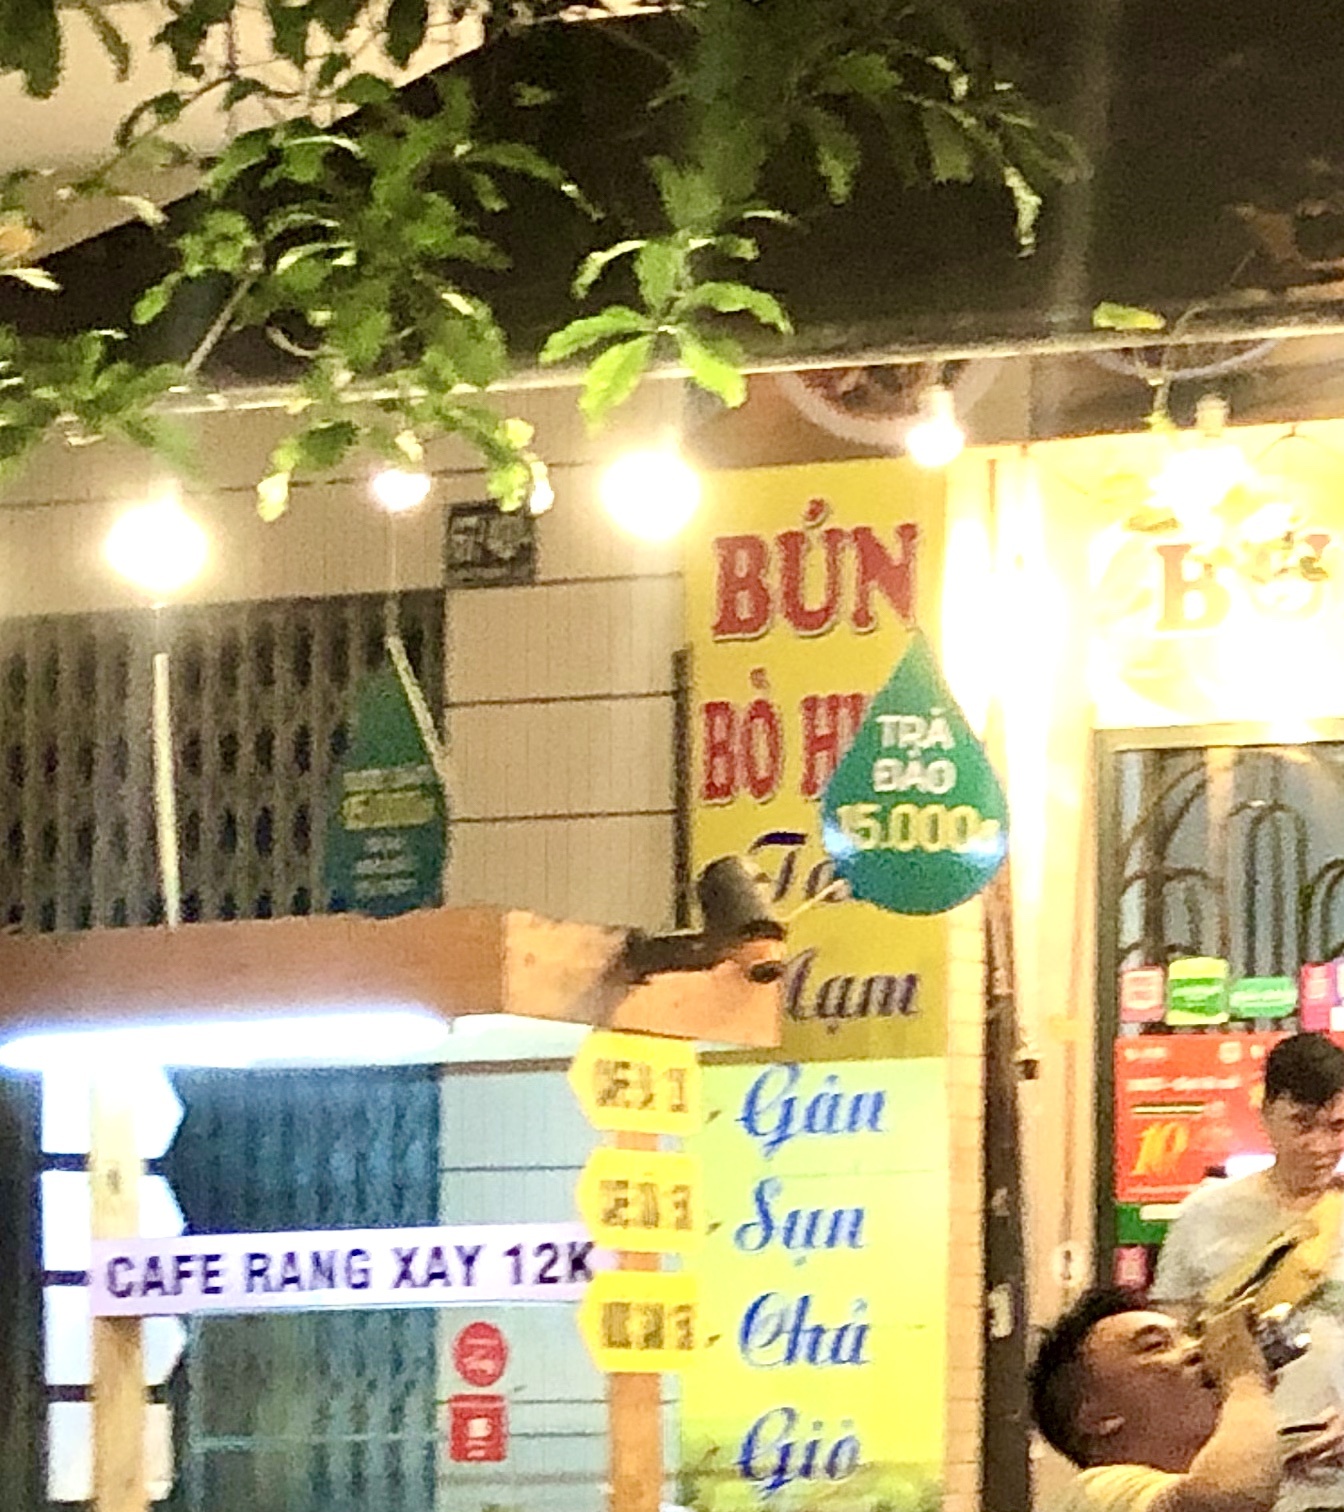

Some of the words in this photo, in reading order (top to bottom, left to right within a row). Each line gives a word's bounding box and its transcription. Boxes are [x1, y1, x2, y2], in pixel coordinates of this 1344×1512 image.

[710, 497, 920, 641] BÚN
[701, 667, 786, 805] BÒ
[106, 1253, 224, 1299] CAFE
[244, 1247, 373, 1294] RANG
[390, 1244, 483, 1289] XAY
[502, 1239, 596, 1287] 12K
[733, 1175, 866, 1267] Sụn
